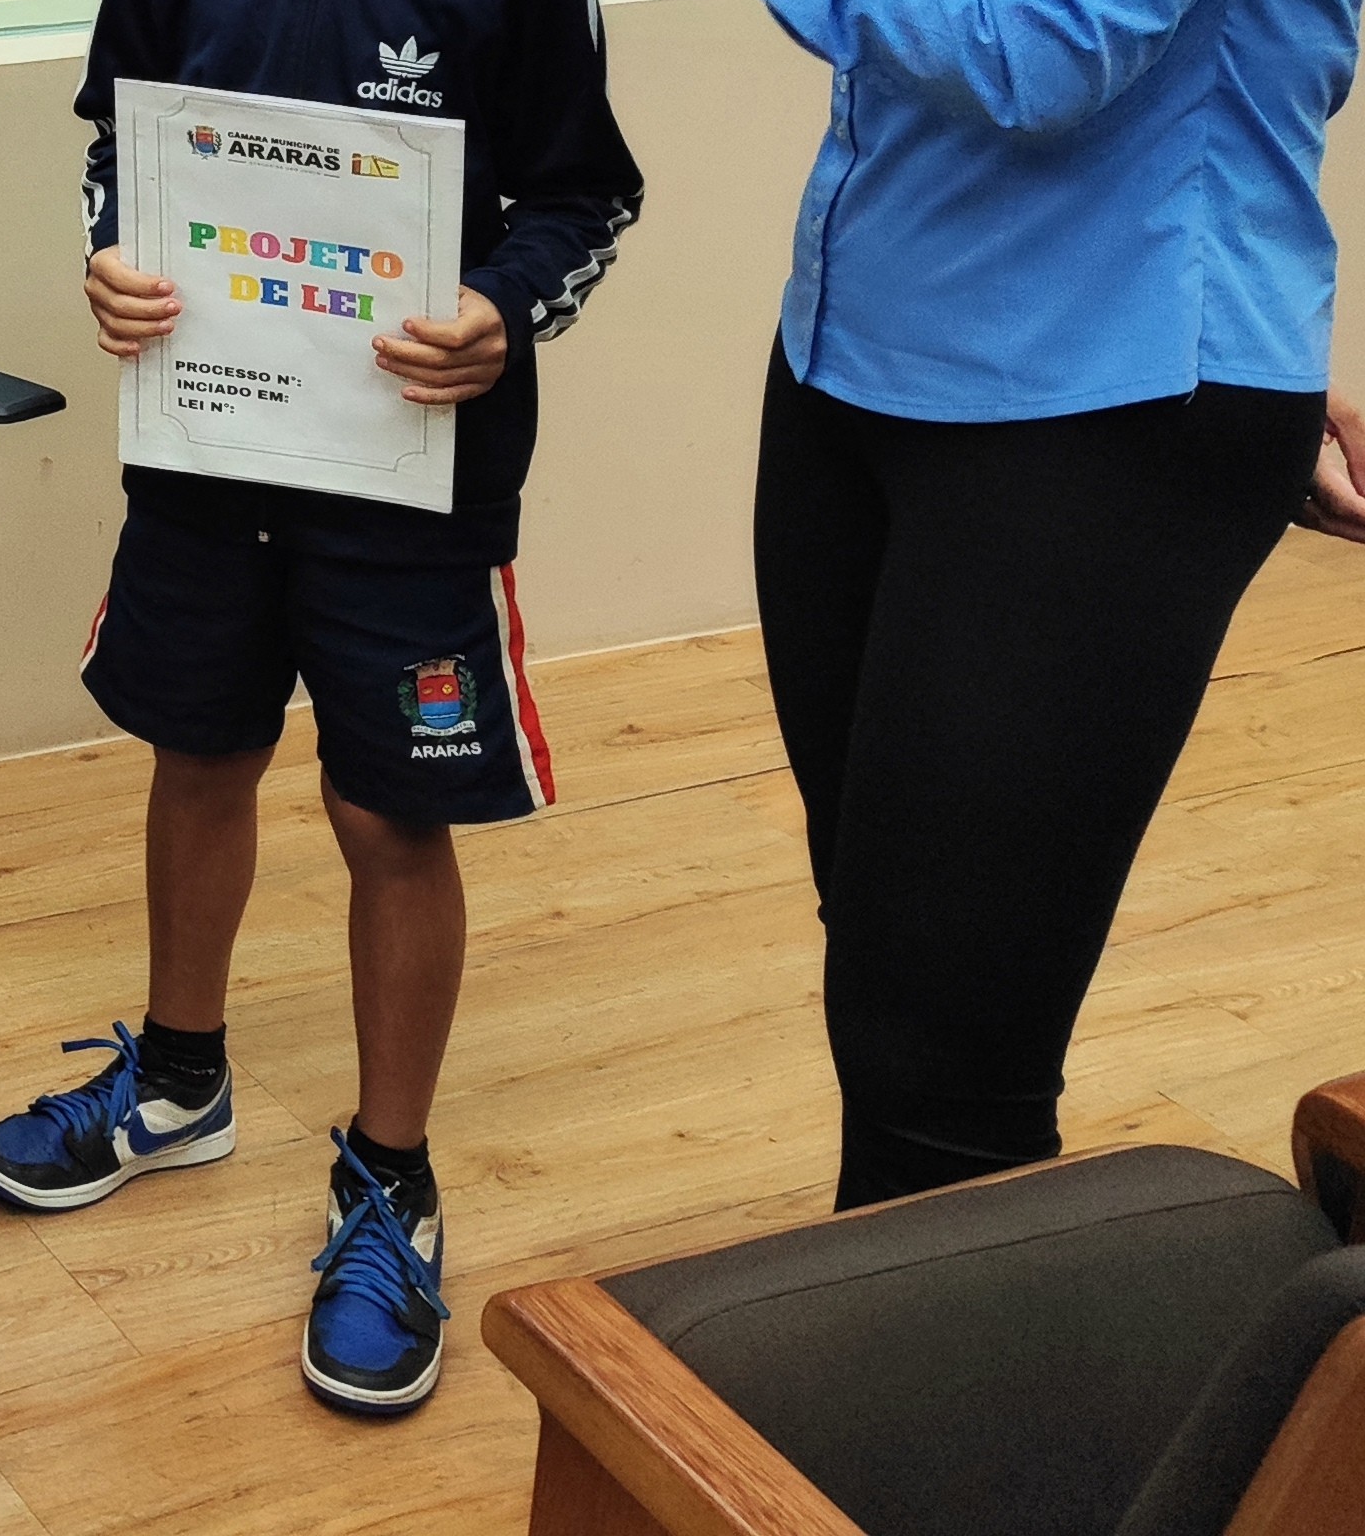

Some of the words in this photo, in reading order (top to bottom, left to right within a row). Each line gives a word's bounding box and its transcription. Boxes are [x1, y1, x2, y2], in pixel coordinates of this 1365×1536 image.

[357, 77, 443, 108] adidas
[227, 130, 268, 144] CÂMARA
[270, 138, 324, 153] MUNICIPAL
[326, 146, 340, 155] DE
[227, 140, 341, 172] ARARAS
[188, 221, 404, 280] PROJETO
[229, 273, 289, 307] DE
[301, 284, 374, 323] LEI
[175, 360, 271, 382] PROCESSO
[177, 378, 252, 397] INCIADO
[257, 389, 290, 404] EM:
[178, 397, 205, 411] LEI
[410, 742, 483, 760] ARARAS
